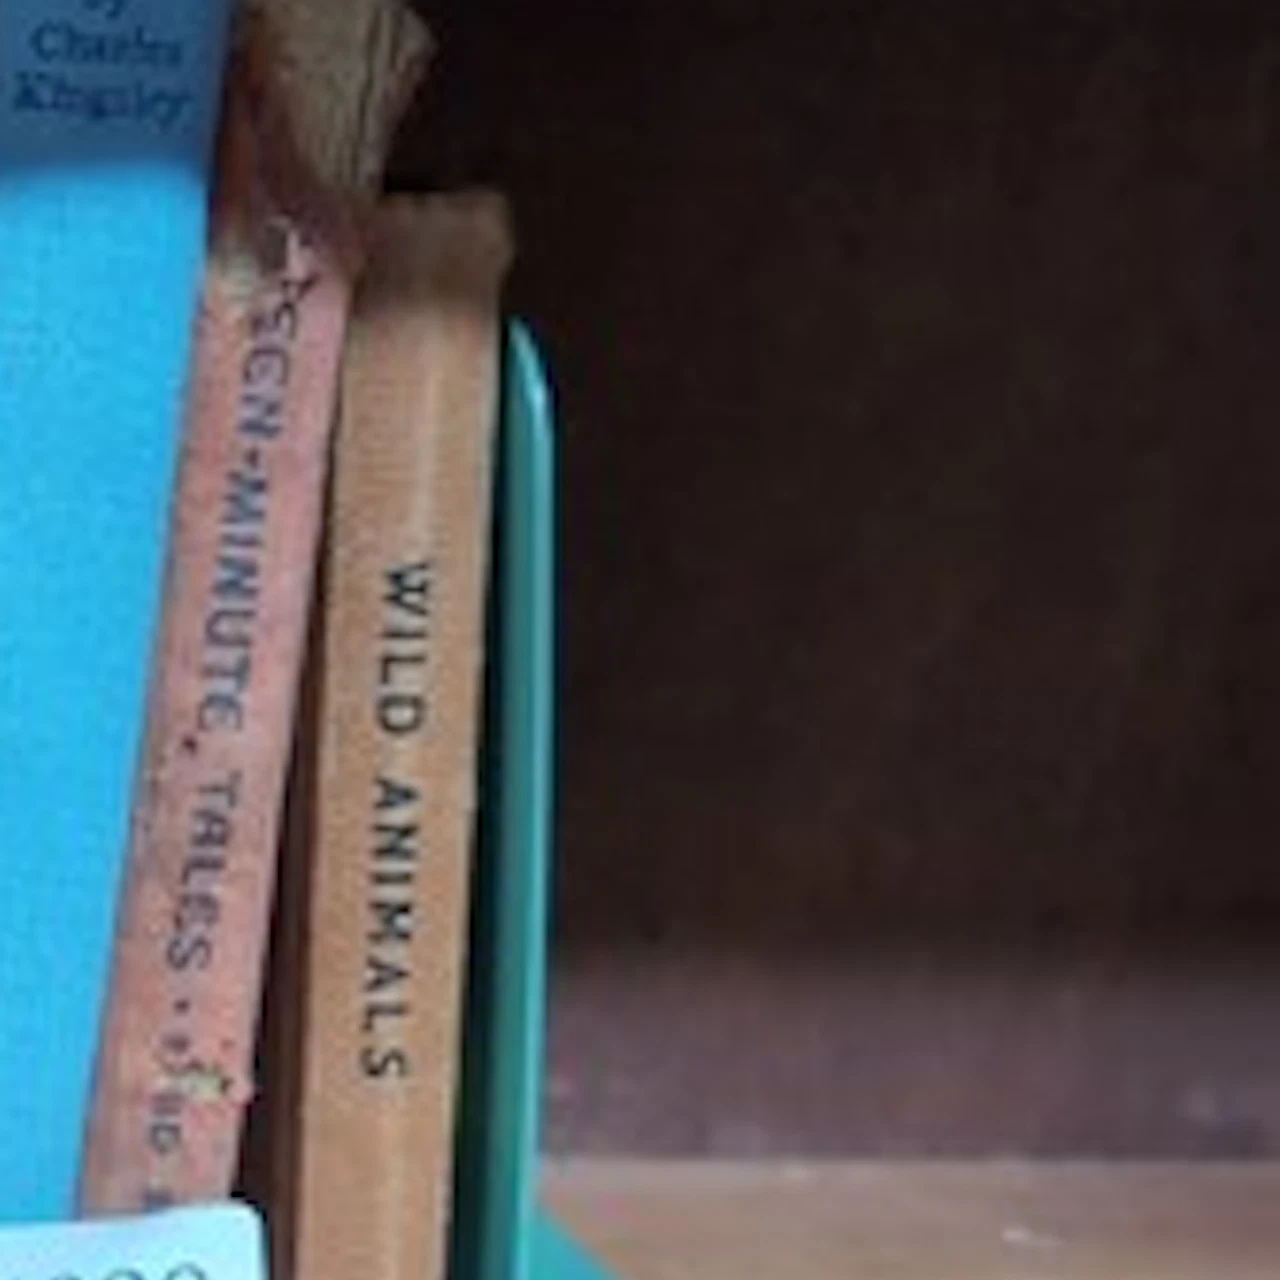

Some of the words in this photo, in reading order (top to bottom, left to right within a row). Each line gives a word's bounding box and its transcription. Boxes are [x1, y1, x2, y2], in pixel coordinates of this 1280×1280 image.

[374, 560, 434, 734] WILD
[165, 770, 242, 975] TALES
[360, 775, 422, 1083] ANIMALS
